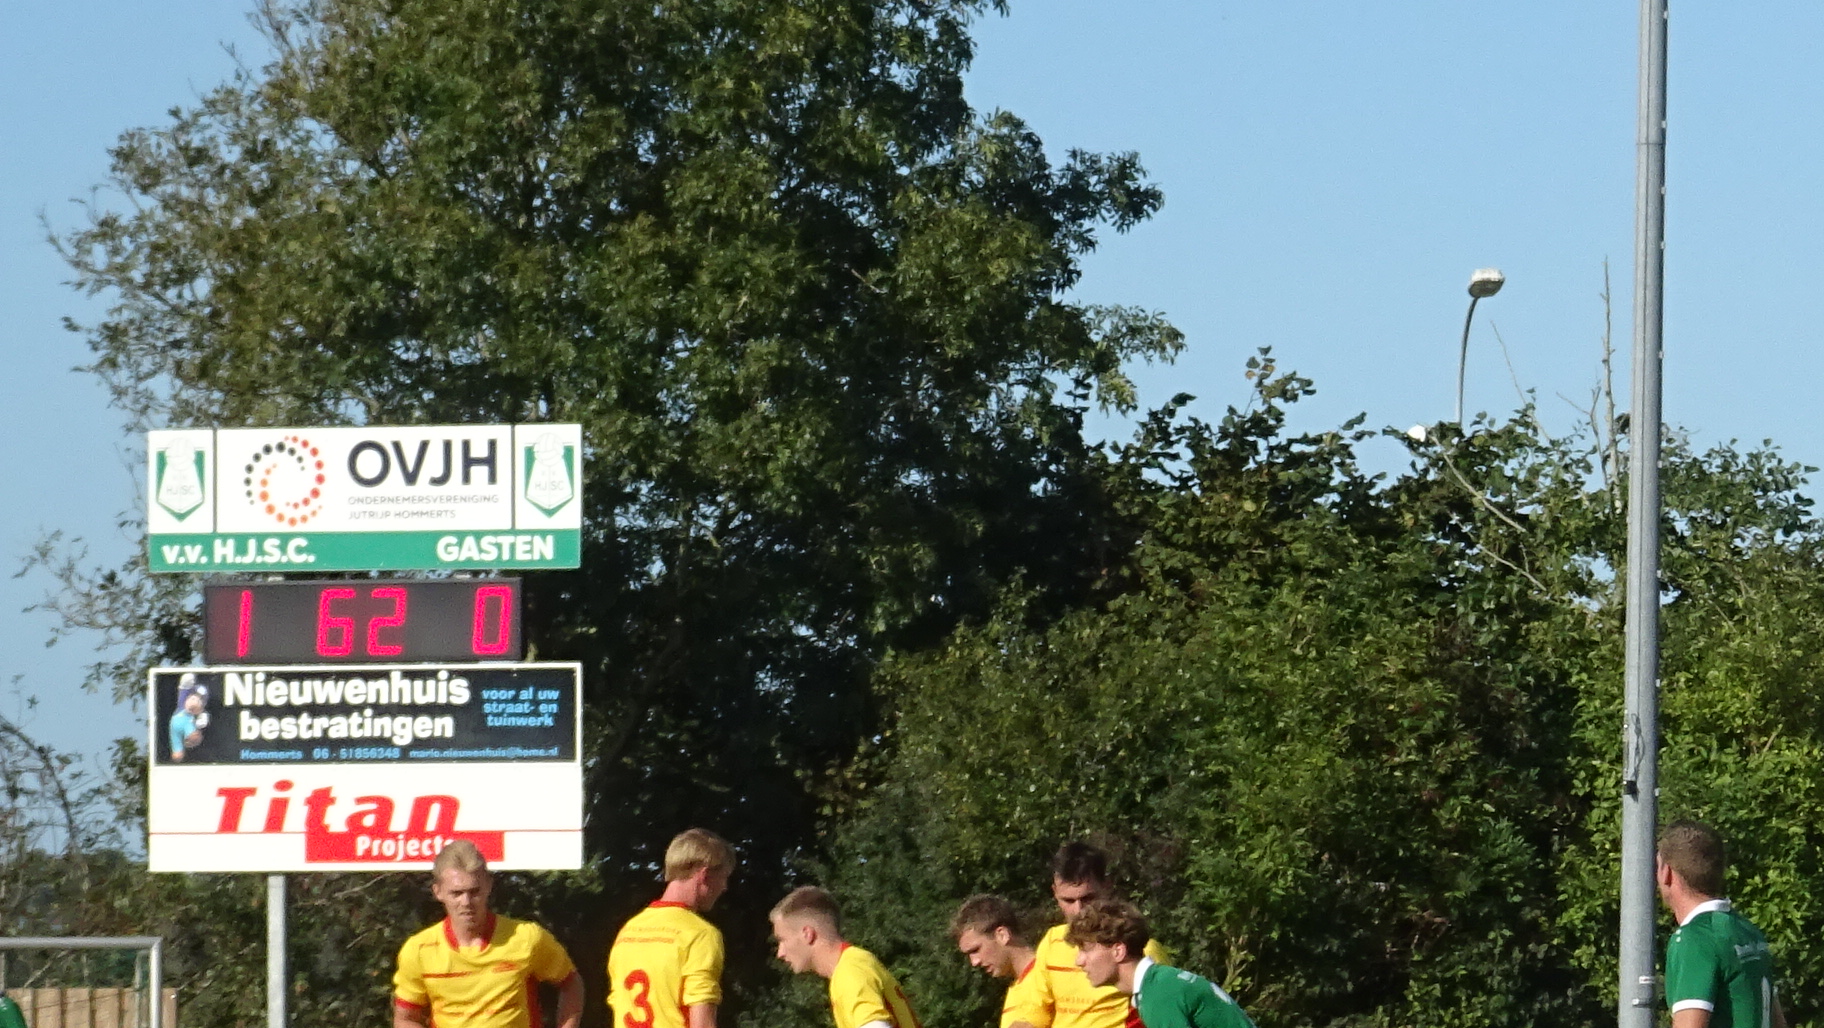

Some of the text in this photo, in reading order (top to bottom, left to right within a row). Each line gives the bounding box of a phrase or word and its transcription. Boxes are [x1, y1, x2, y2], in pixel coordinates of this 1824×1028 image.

[347, 439, 498, 488] OVJH
[161, 538, 316, 565] v.v. H.J.S.C.
[436, 535, 554, 562] GASTEN
[237, 586, 512, 658] 1 62 0
[224, 671, 470, 707] Nieuwenhuis
[482, 688, 560, 701] voor al uw
[487, 714, 555, 727] tuinwerk
[539, 702, 558, 714] en
[240, 711, 454, 745] bestratingen
[216, 779, 461, 834] Titan
[356, 835, 458, 861] Project
